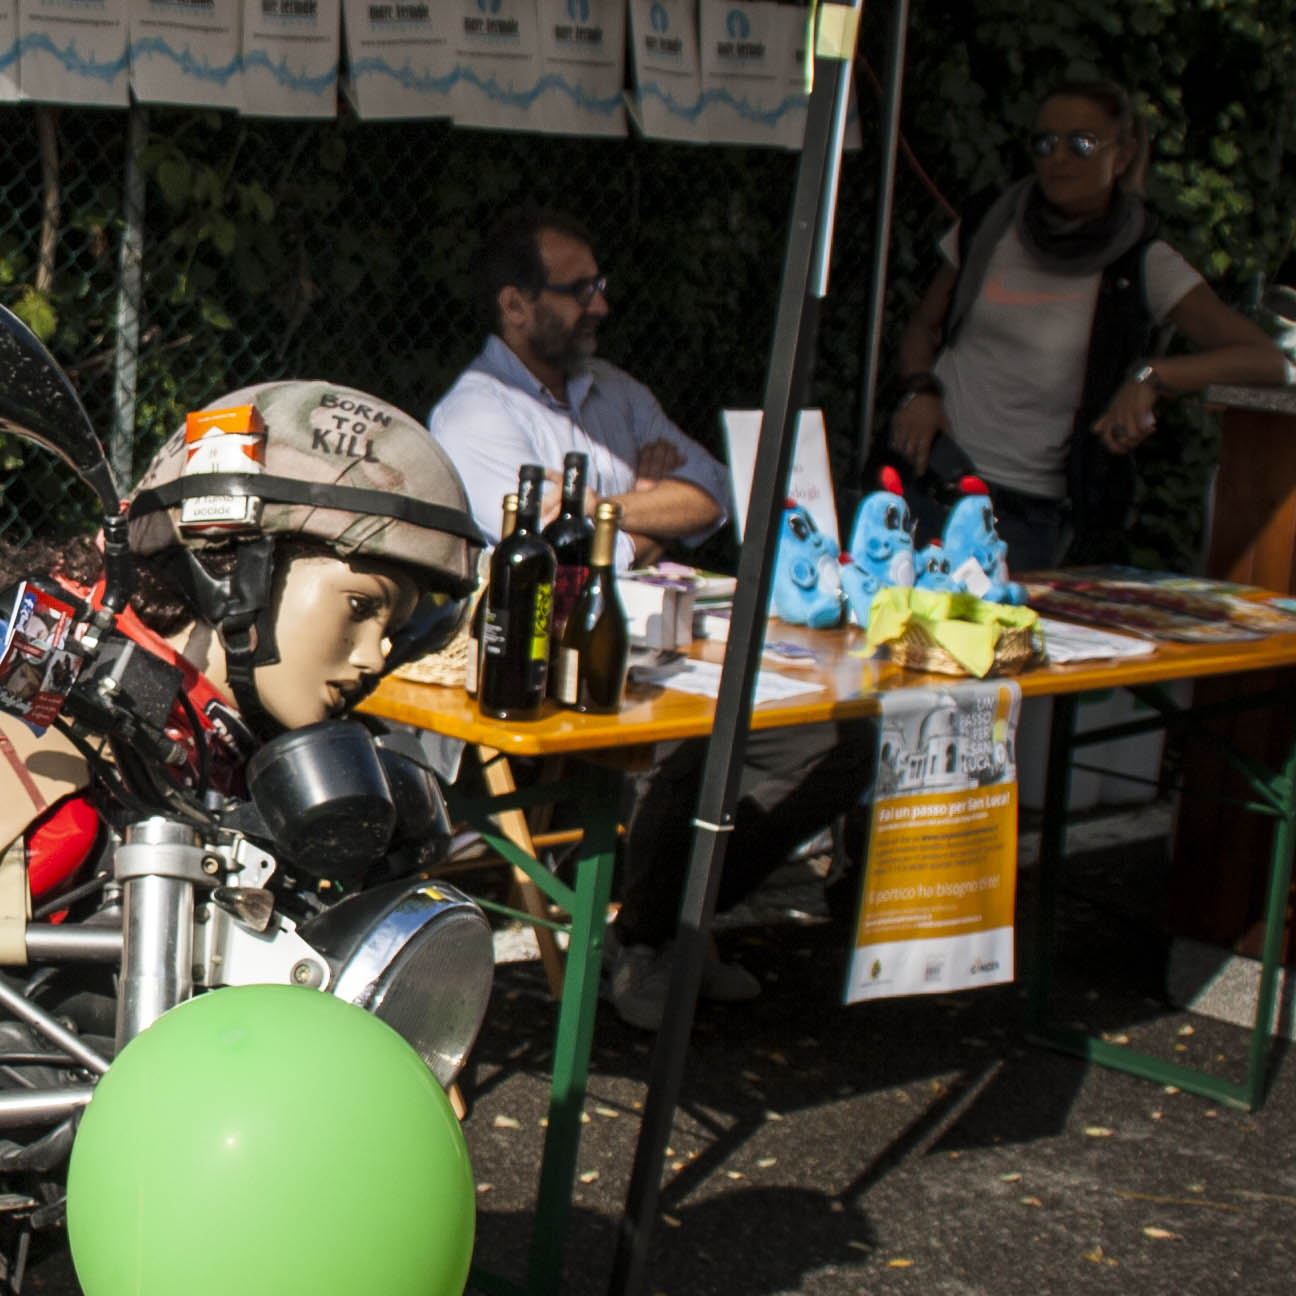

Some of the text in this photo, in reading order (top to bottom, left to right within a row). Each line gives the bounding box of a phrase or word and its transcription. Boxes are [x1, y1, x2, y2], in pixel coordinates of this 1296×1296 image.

[320, 394, 393, 427] BORN
[331, 414, 367, 434] TO
[312, 428, 380, 463] KILL
[895, 805, 911, 820] un
[911, 803, 947, 822] passo
[949, 800, 967, 817] per
[967, 796, 985, 812] San
[985, 791, 1010, 809] Luca!
[876, 885, 917, 906] portico
[917, 883, 935, 898] ha
[935, 879, 978, 900] bisogno
